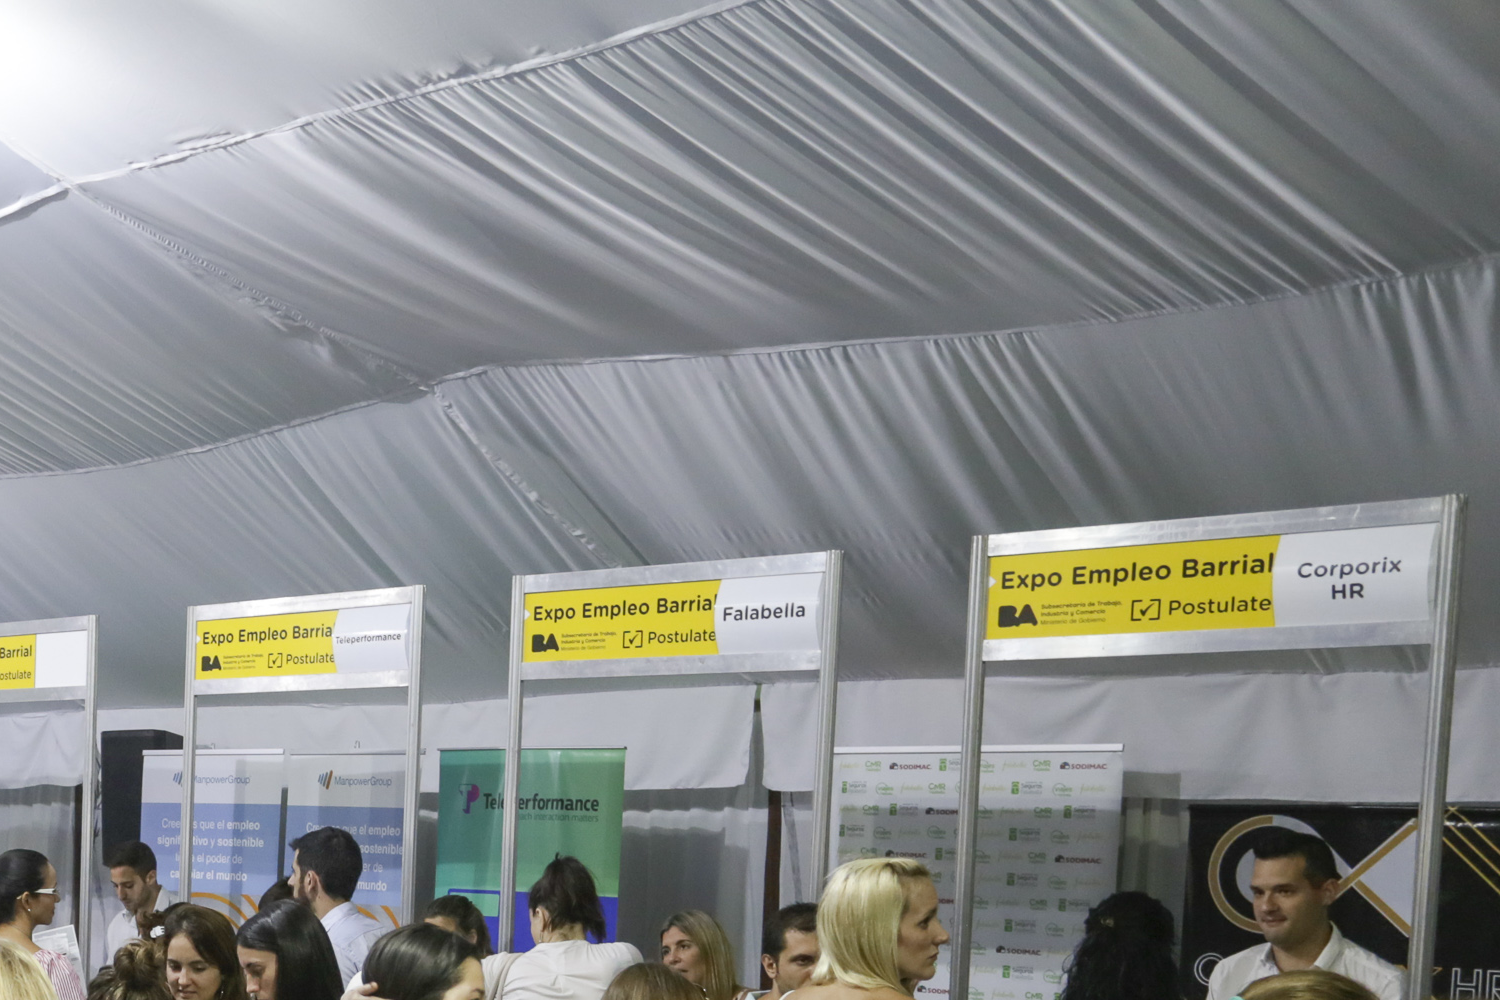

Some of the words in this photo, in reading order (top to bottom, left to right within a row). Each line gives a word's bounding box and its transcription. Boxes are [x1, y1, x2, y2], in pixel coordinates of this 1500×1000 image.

[1001, 571, 1062, 591] Expo
[1072, 562, 1172, 586] Empleo
[1182, 552, 1274, 578] Barrial
[1297, 556, 1402, 580] Corporix
[1331, 582, 1365, 600] HR
[533, 605, 576, 623] Expo
[582, 600, 650, 620] Empleo
[722, 603, 806, 622] Falabella
[1168, 596, 1272, 616] Postulate
[203, 632, 234, 646] Expo
[239, 627, 288, 643] Empleo
[336, 632, 402, 645] Teleperformance
[648, 628, 717, 644] Postulate
[0, 645, 32, 659] Barrial
[286, 652, 335, 665] Postulate
[334, 776, 392, 788] ManpowerGroup
[200, 821, 215, 831] que
[217, 820, 225, 829] el
[226, 820, 261, 832] empleo
[359, 825, 367, 834] el
[368, 825, 401, 838] empleo
[210, 838, 215, 848] y
[217, 837, 264, 848] sostenible
[360, 844, 403, 855] sostenible
[197, 853, 204, 862] el
[206, 853, 231, 864] poder
[232, 855, 243, 864] de
[373, 863, 383, 872] de
[206, 870, 214, 880] el
[216, 872, 248, 882] mundo
[357, 881, 387, 891] mundo
[1006, 947, 1041, 956] SODIMAC
[1025, 992, 1043, 1000] CMR
